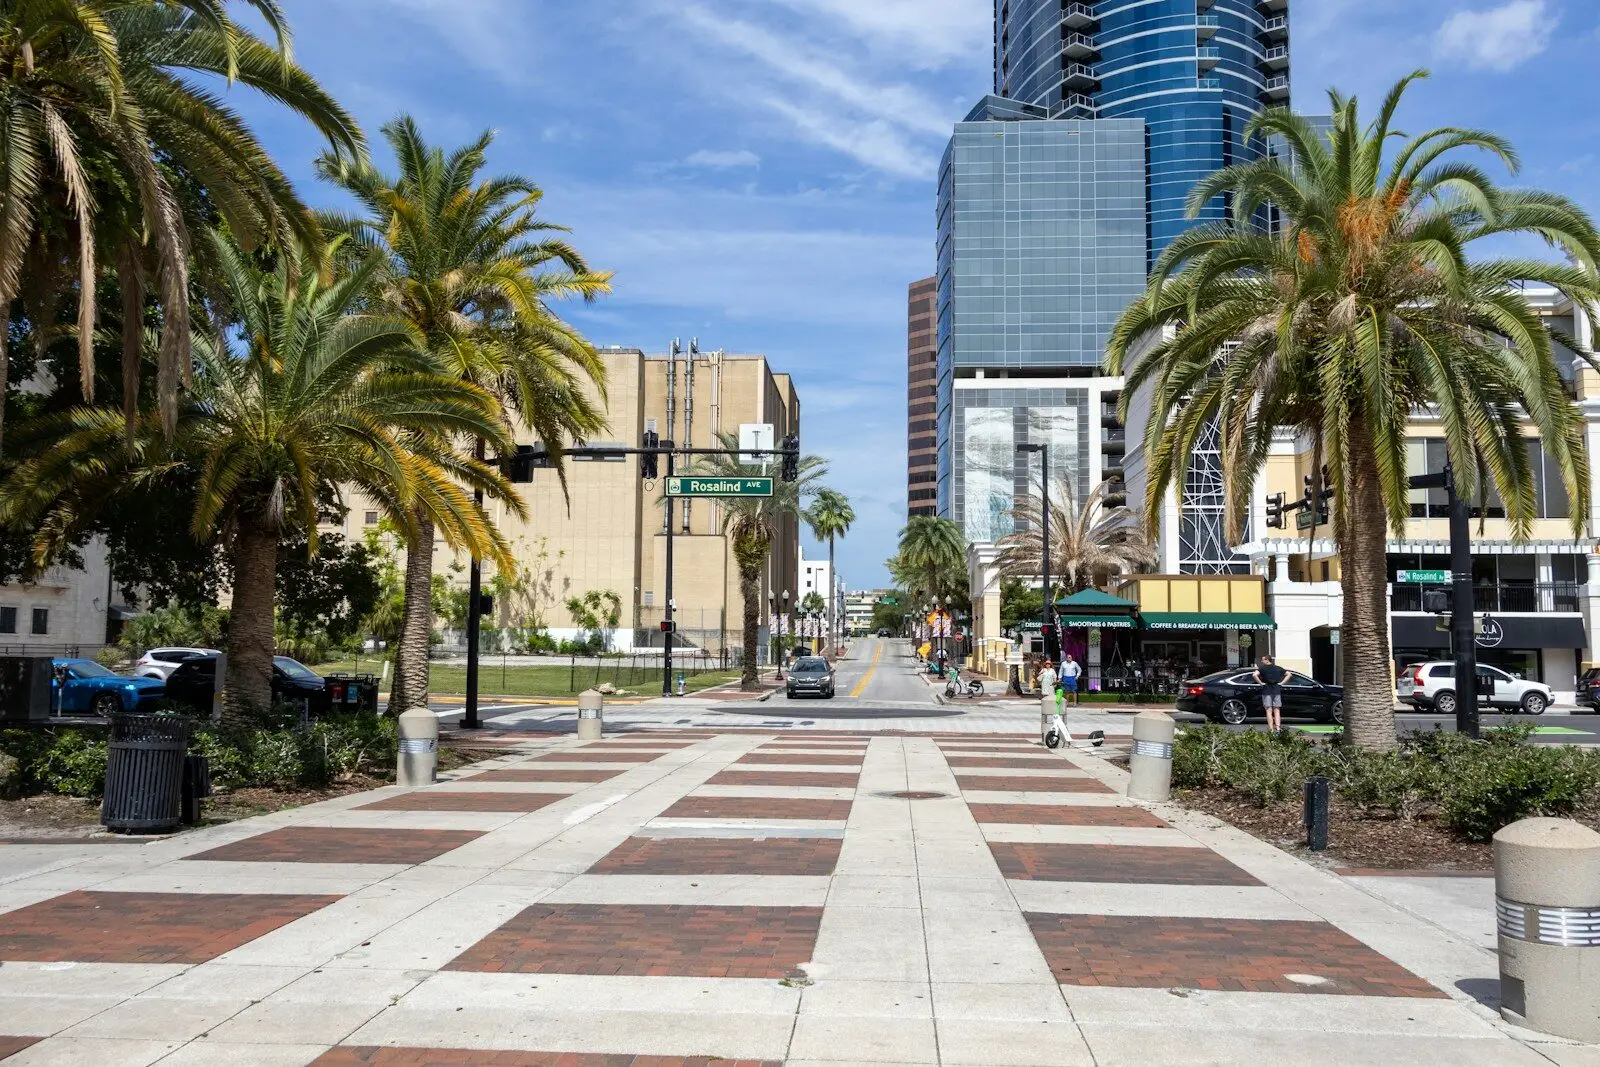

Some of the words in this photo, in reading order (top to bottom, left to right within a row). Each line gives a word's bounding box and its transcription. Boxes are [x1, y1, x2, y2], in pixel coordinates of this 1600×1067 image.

[690, 480, 741, 492] Rosalind
[1405, 572, 1411, 580] N
[1412, 572, 1437, 580] Rosalind
